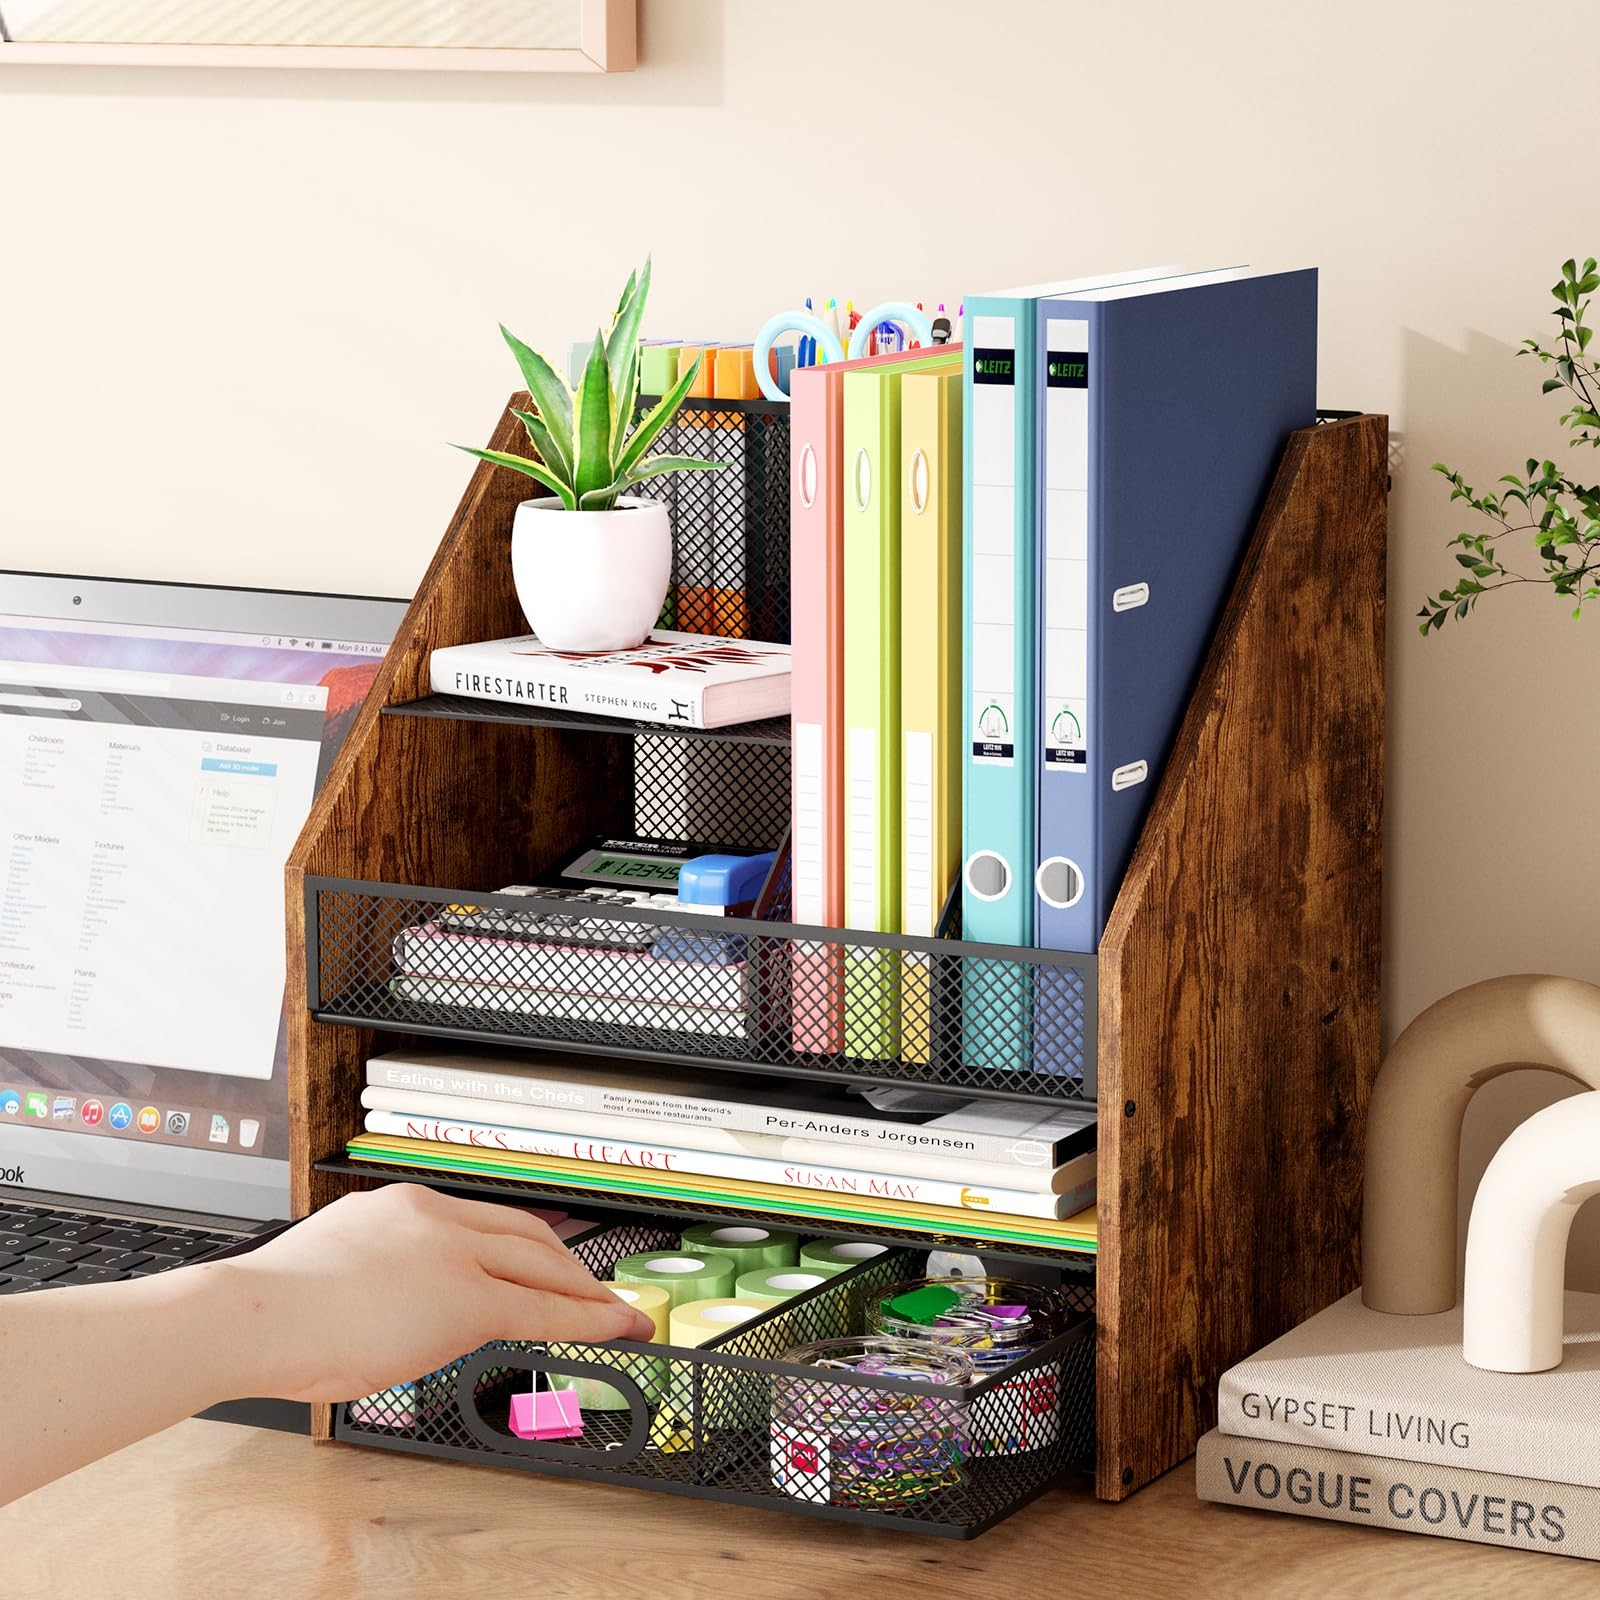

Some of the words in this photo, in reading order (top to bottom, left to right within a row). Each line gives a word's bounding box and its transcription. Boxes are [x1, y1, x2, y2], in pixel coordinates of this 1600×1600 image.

[983, 360, 1011, 374] LEITZ
[1057, 363, 1085, 377] LEITZ
[337, 643, 352, 651] Mon
[455, 672, 569, 704] FIRESTARTER
[585, 693, 628, 708] STEPHEN
[632, 699, 658, 712] KING
[233, 715, 250, 723] Login
[216, 744, 251, 754] Database
[386, 1070, 444, 1090] Eating
[451, 1078, 488, 1095] with
[494, 1083, 522, 1097] the
[529, 1086, 585, 1105] Chefs
[603, 1094, 632, 1106] Family
[634, 1098, 660, 1107] meals
[662, 1101, 682, 1110] from
[684, 1103, 699, 1111] the
[701, 1105, 732, 1116] world's
[603, 1104, 625, 1112] most
[627, 1106, 661, 1116] creative
[663, 1110, 713, 1122] restaurants
[766, 1116, 870, 1138] Per-Anders
[878, 1130, 975, 1150] Jorgensen
[784, 1168, 857, 1191] SUSAN
[869, 1179, 920, 1199] MAY
[1241, 1392, 1355, 1432] GYPSET
[1369, 1409, 1470, 1449] LIVING
[1223, 1457, 1372, 1515] VOGUE
[1388, 1482, 1567, 1544] COVERS
